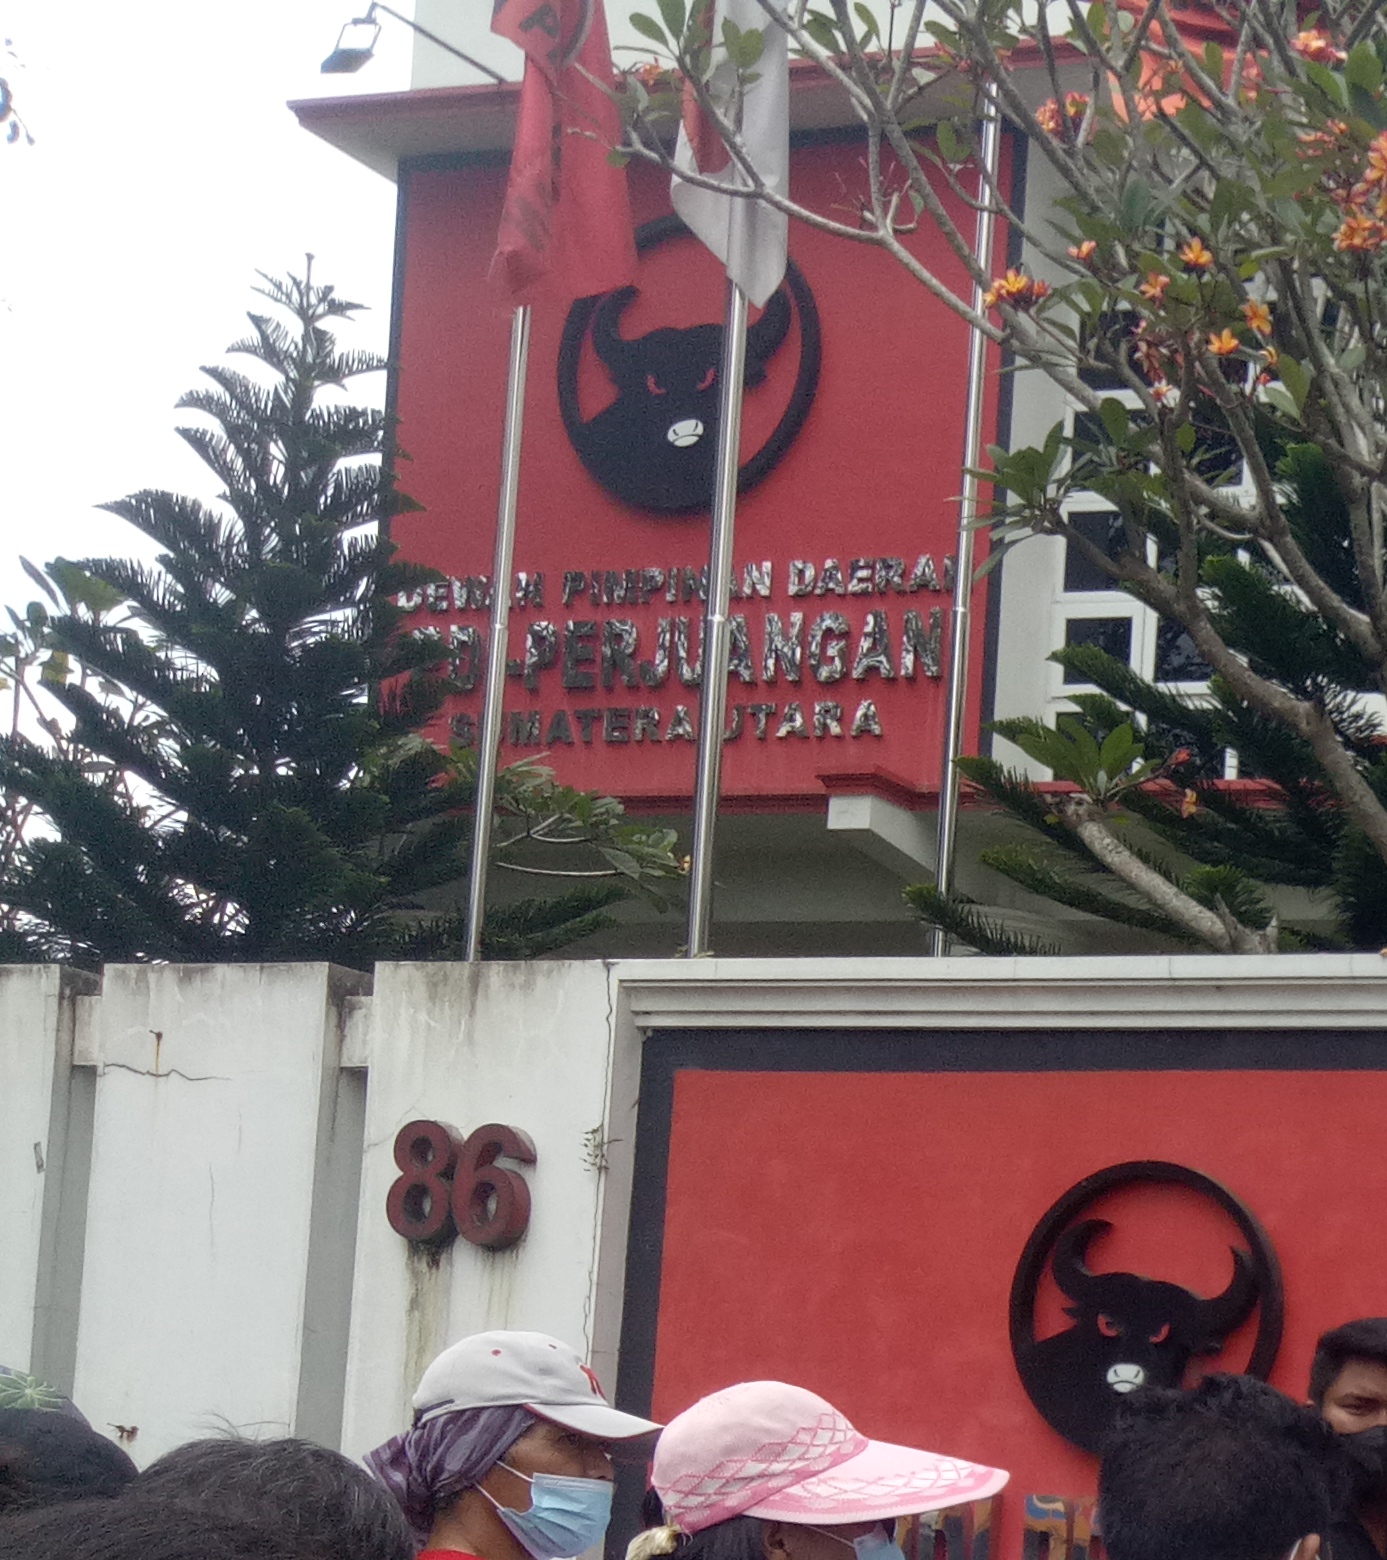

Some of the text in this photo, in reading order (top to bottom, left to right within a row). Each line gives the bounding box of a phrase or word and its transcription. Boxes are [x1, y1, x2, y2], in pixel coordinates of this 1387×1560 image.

[396, 572, 544, 612] DEWN
[448, 704, 696, 747] SMATERA
[386, 1120, 537, 1250] 86
